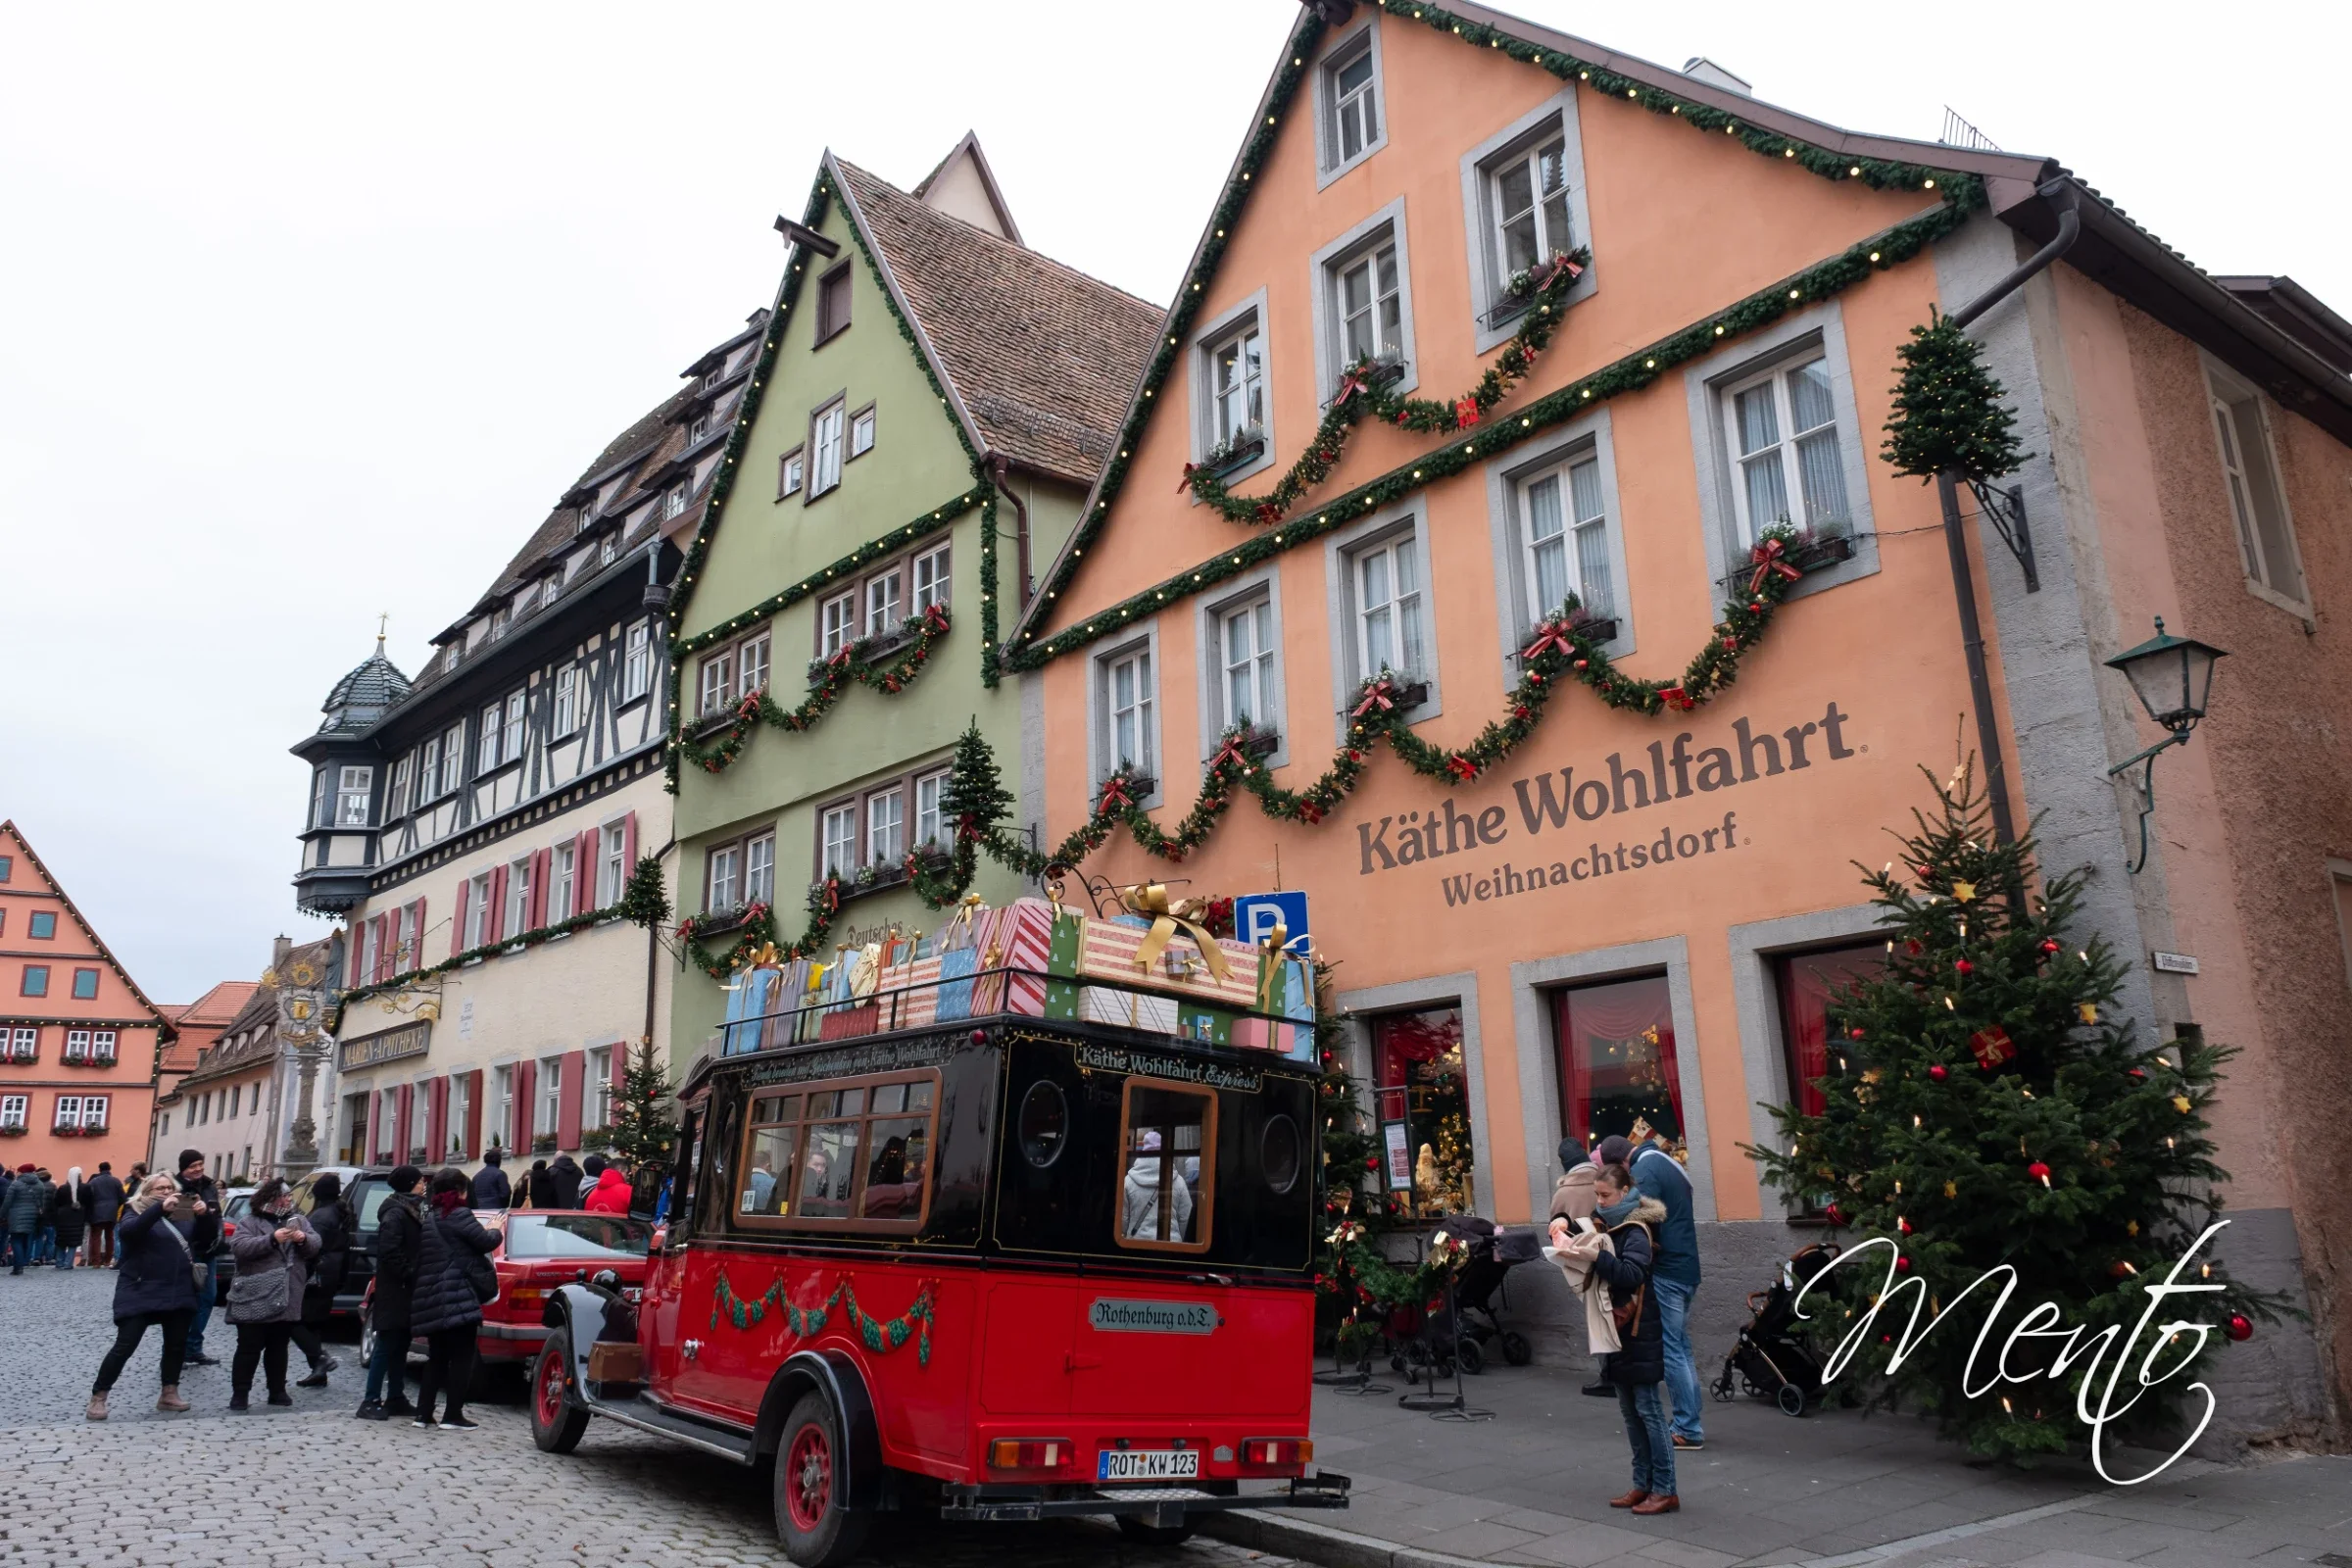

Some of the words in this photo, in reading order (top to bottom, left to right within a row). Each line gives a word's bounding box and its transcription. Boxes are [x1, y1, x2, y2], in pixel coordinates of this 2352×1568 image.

[1356, 797, 1508, 876] Käthe
[1511, 700, 1855, 835] Wohlfahrt
[1441, 810, 1737, 907] Weihnachtsdorf
[897, 1044, 942, 1063] Wohlfahrt
[1082, 1046, 1127, 1070] Käthe
[1130, 1054, 1202, 1082] Wohlfahrt
[1205, 1063, 1257, 1090] Express
[1096, 1302, 1174, 1330] Rothenburg
[1108, 1454, 1138, 1476] ROT
[1149, 1454, 1167, 1475] KW
[1169, 1454, 1198, 1475] 123
